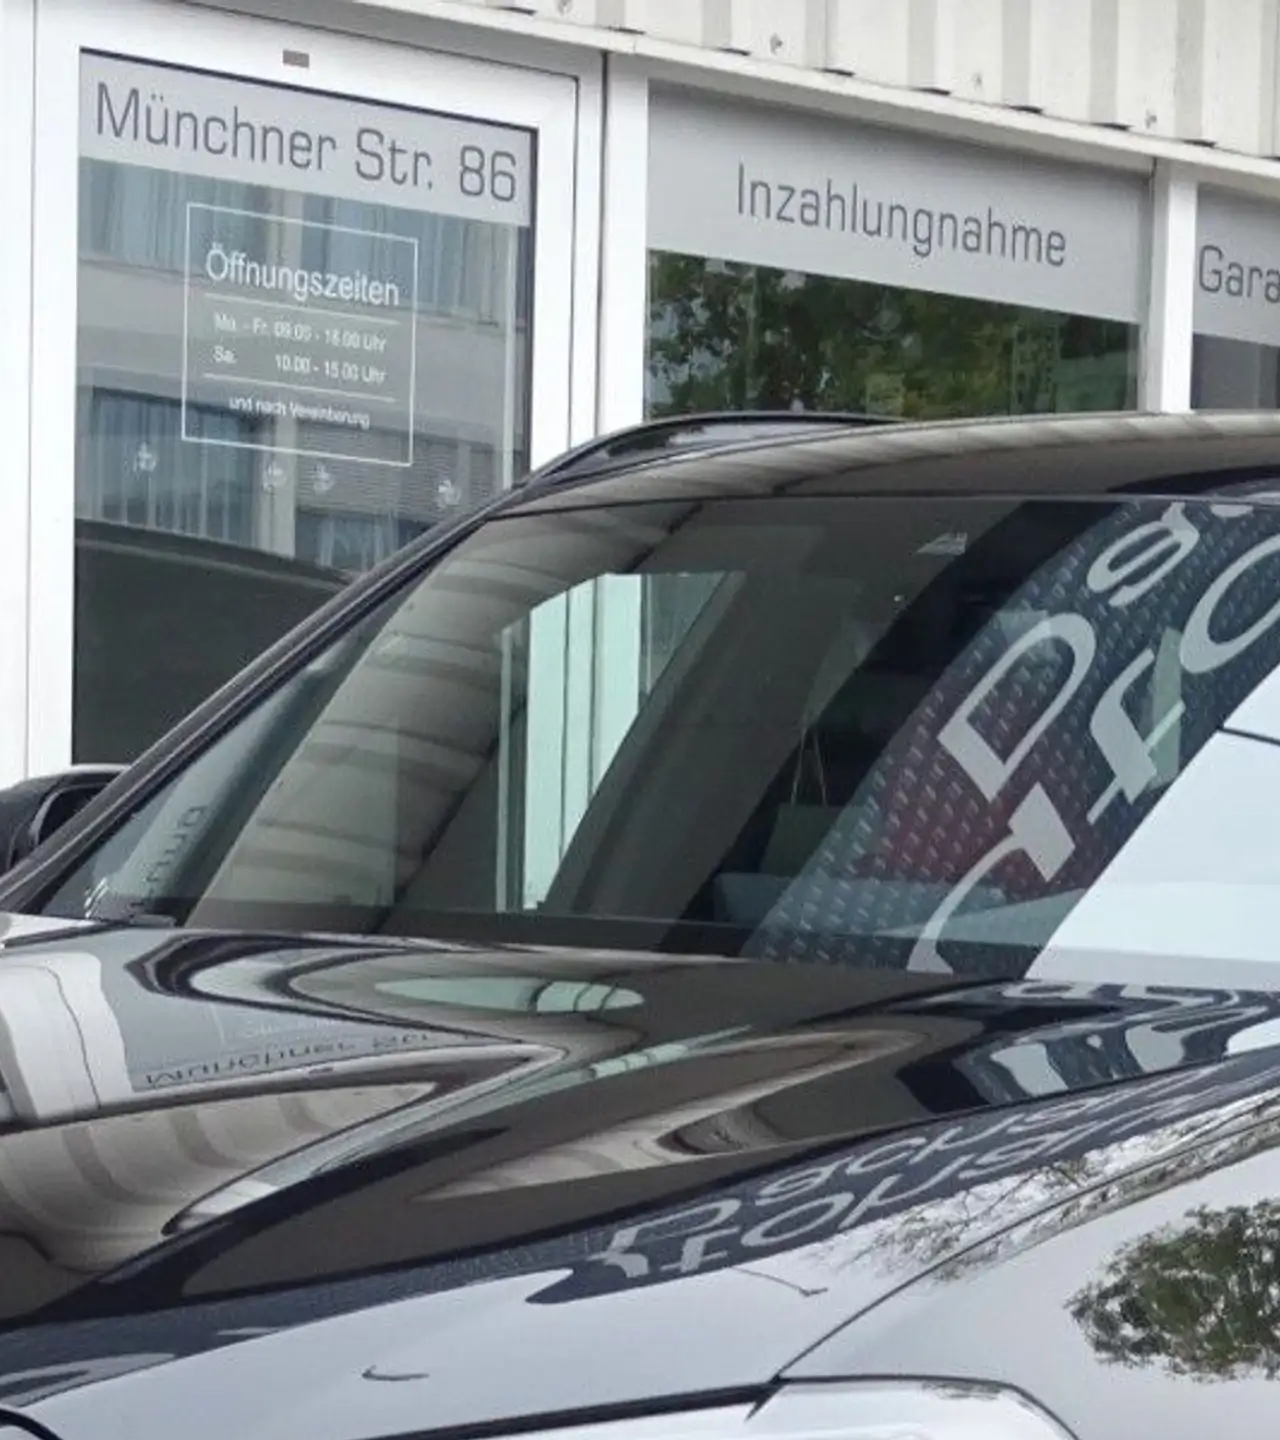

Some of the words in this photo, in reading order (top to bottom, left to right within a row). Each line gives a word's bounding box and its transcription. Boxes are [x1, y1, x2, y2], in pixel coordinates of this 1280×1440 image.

[96, 81, 337, 170] Münchner
[354, 127, 433, 191] Str.
[458, 145, 517, 203] 86
[737, 161, 1067, 268] Inzahlungnahme
[205, 240, 401, 306] Öffnungszeiten
[361, 365, 388, 386] Uhr
[363, 334, 388, 353] Uhr
